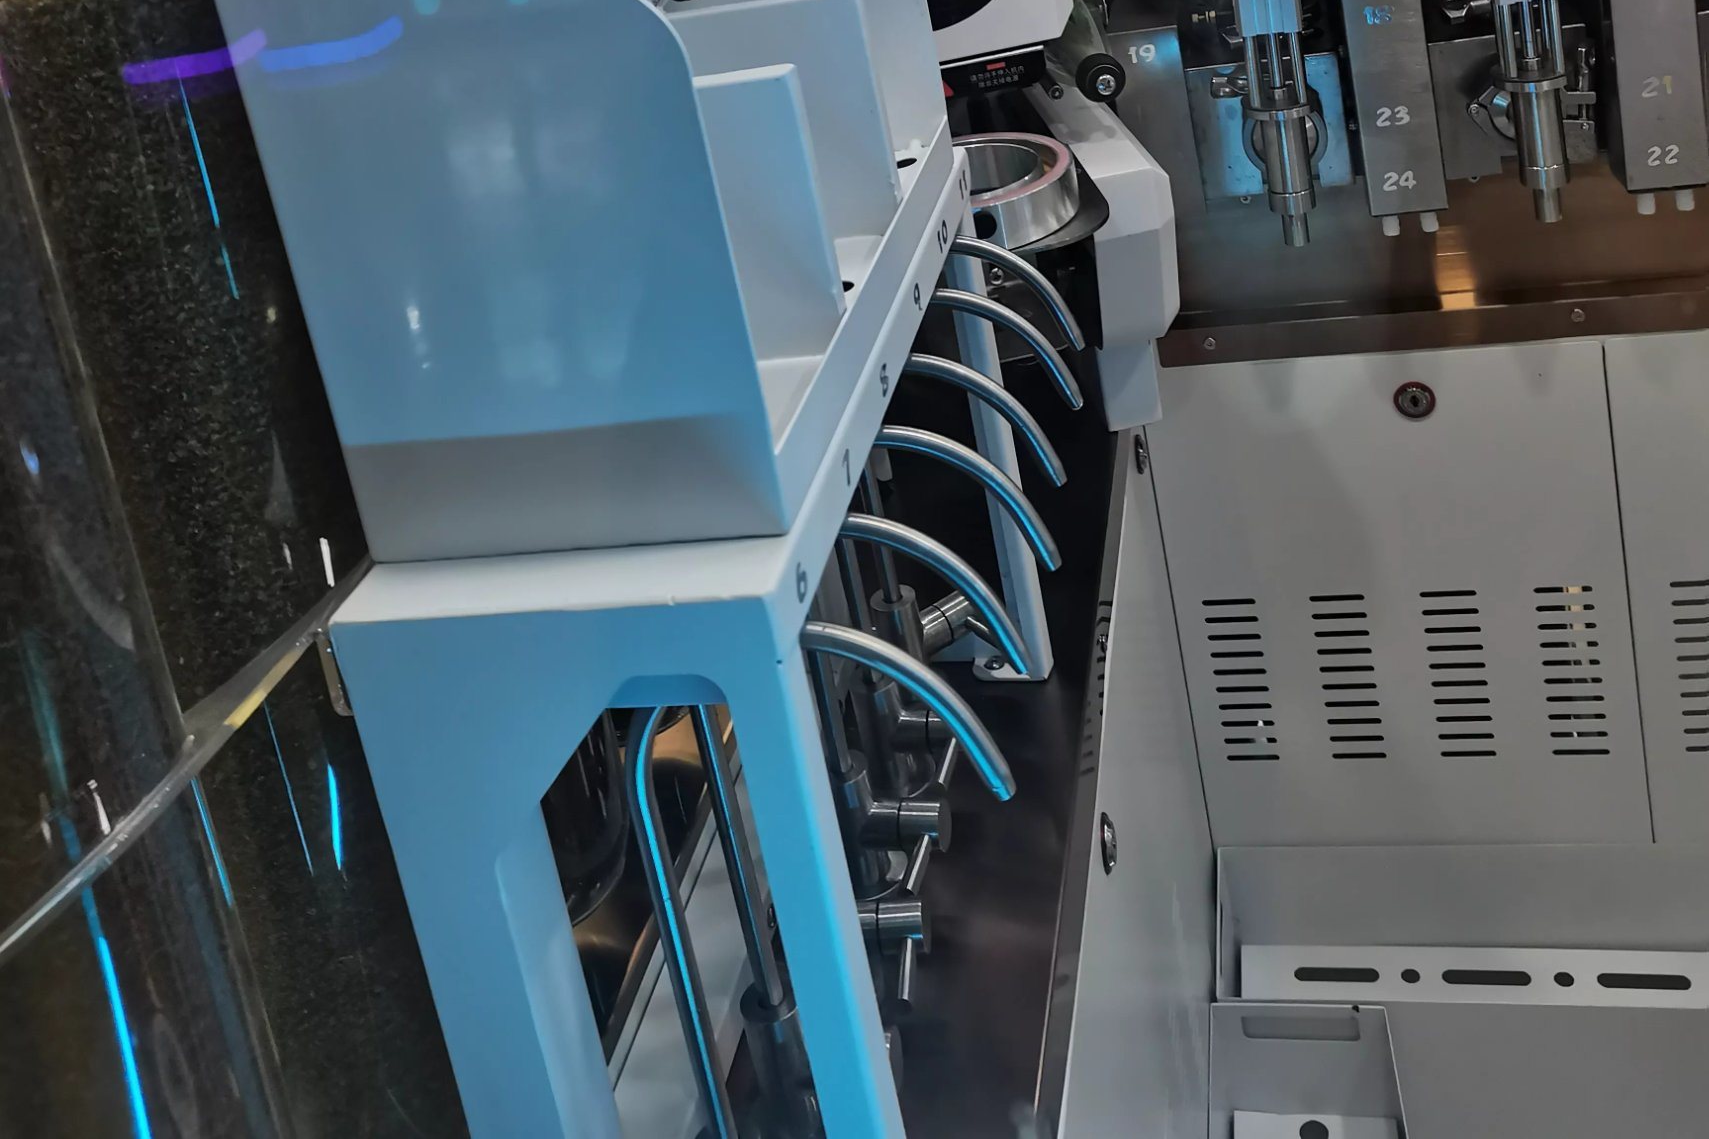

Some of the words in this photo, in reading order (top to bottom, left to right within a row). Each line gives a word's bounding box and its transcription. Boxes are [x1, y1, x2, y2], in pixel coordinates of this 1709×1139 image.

[1128, 44, 1156, 64] 19
[1642, 75, 1673, 99] 21
[1376, 106, 1411, 128] 23
[1647, 144, 1680, 167] 22
[1382, 170, 1417, 192] 24
[937, 219, 949, 254] 10
[913, 282, 923, 311] 9
[796, 562, 808, 604] 6
